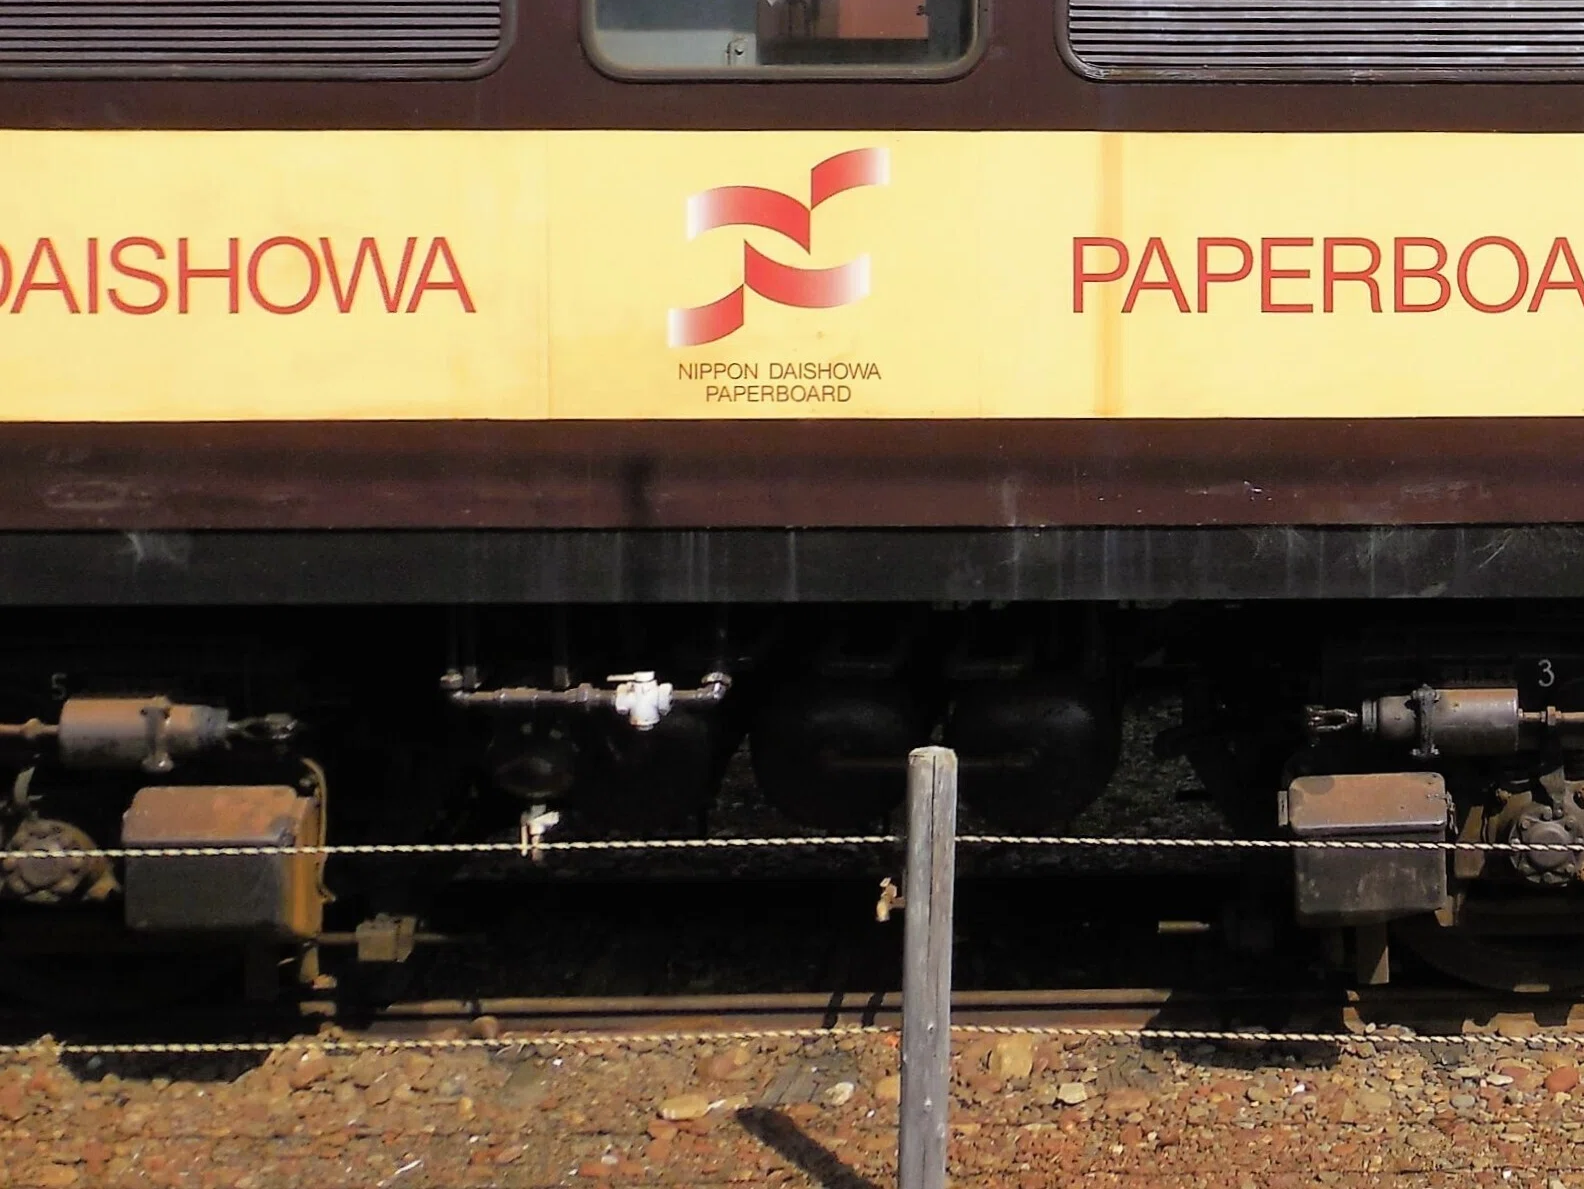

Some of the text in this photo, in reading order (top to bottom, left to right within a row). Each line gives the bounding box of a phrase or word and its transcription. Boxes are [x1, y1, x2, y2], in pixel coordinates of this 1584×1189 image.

[0, 237, 475, 314] AISHOWA
[678, 362, 882, 381] NIPPON DAISHOWA
[705, 385, 852, 403] PAPERBOARD
[1538, 659, 1555, 687] 3
